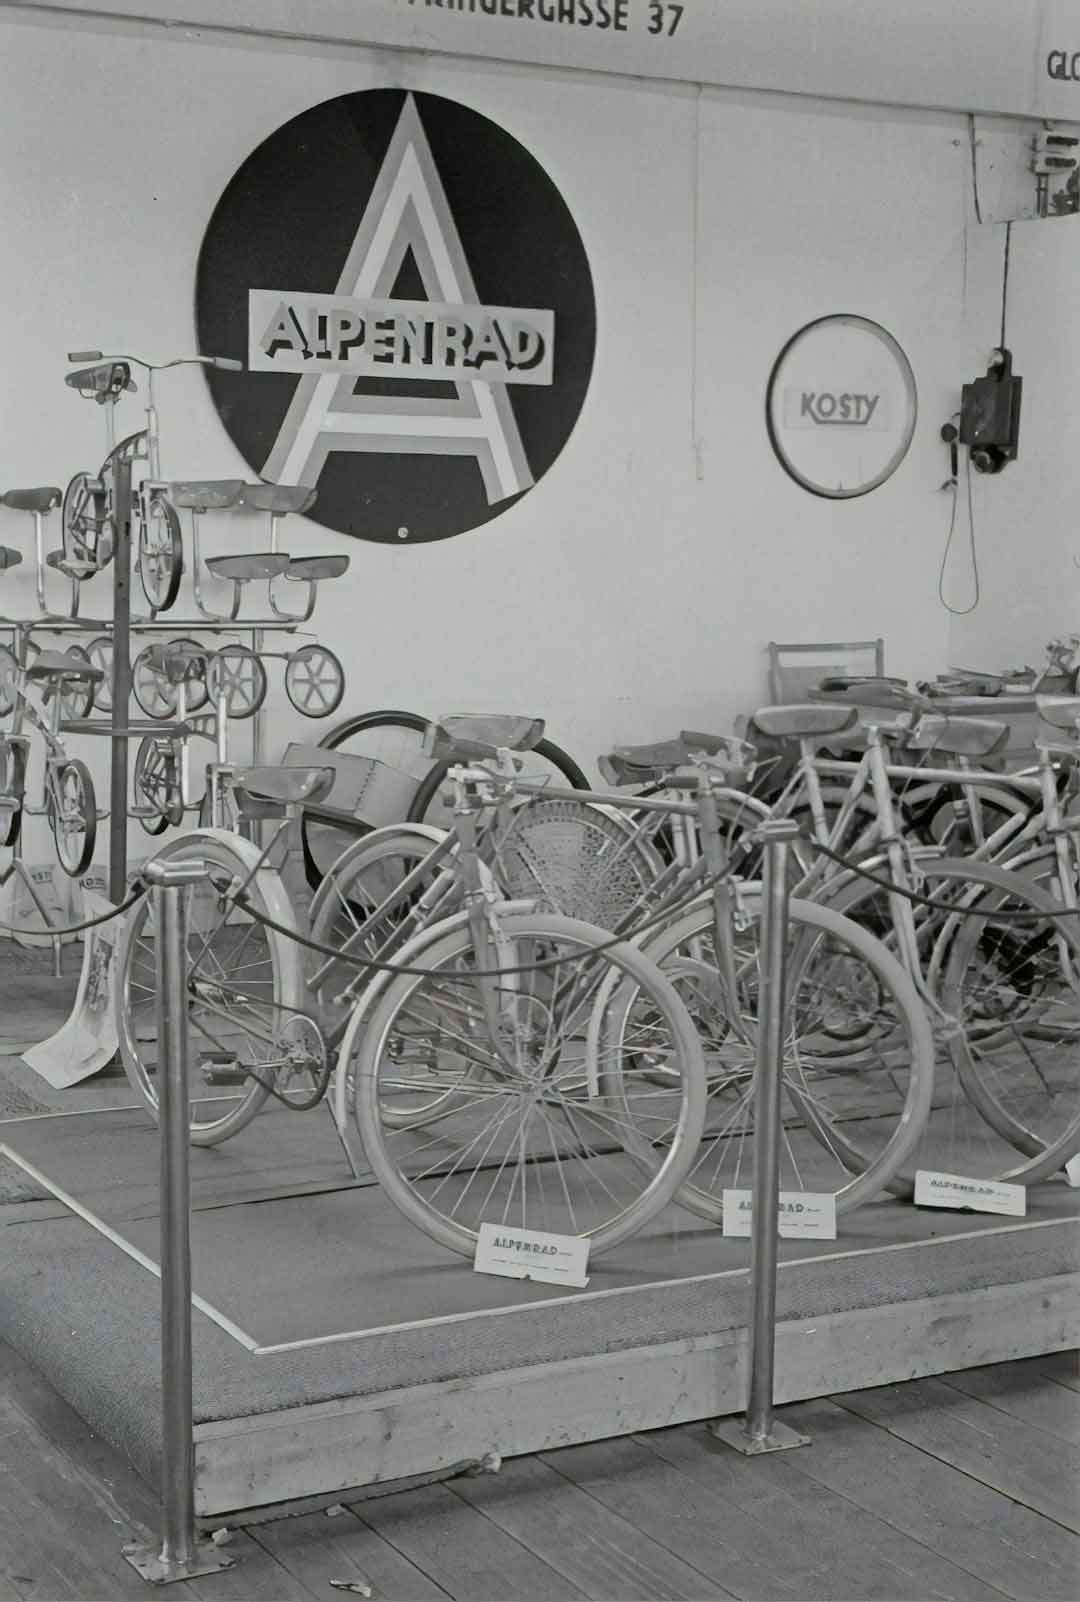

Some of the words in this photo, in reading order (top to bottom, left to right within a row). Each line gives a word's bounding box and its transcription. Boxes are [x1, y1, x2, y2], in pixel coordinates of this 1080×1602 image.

[647, 3, 685, 37] 37
[259, 301, 546, 371] ALPENRAD
[800, 392, 880, 425] KOSTY
